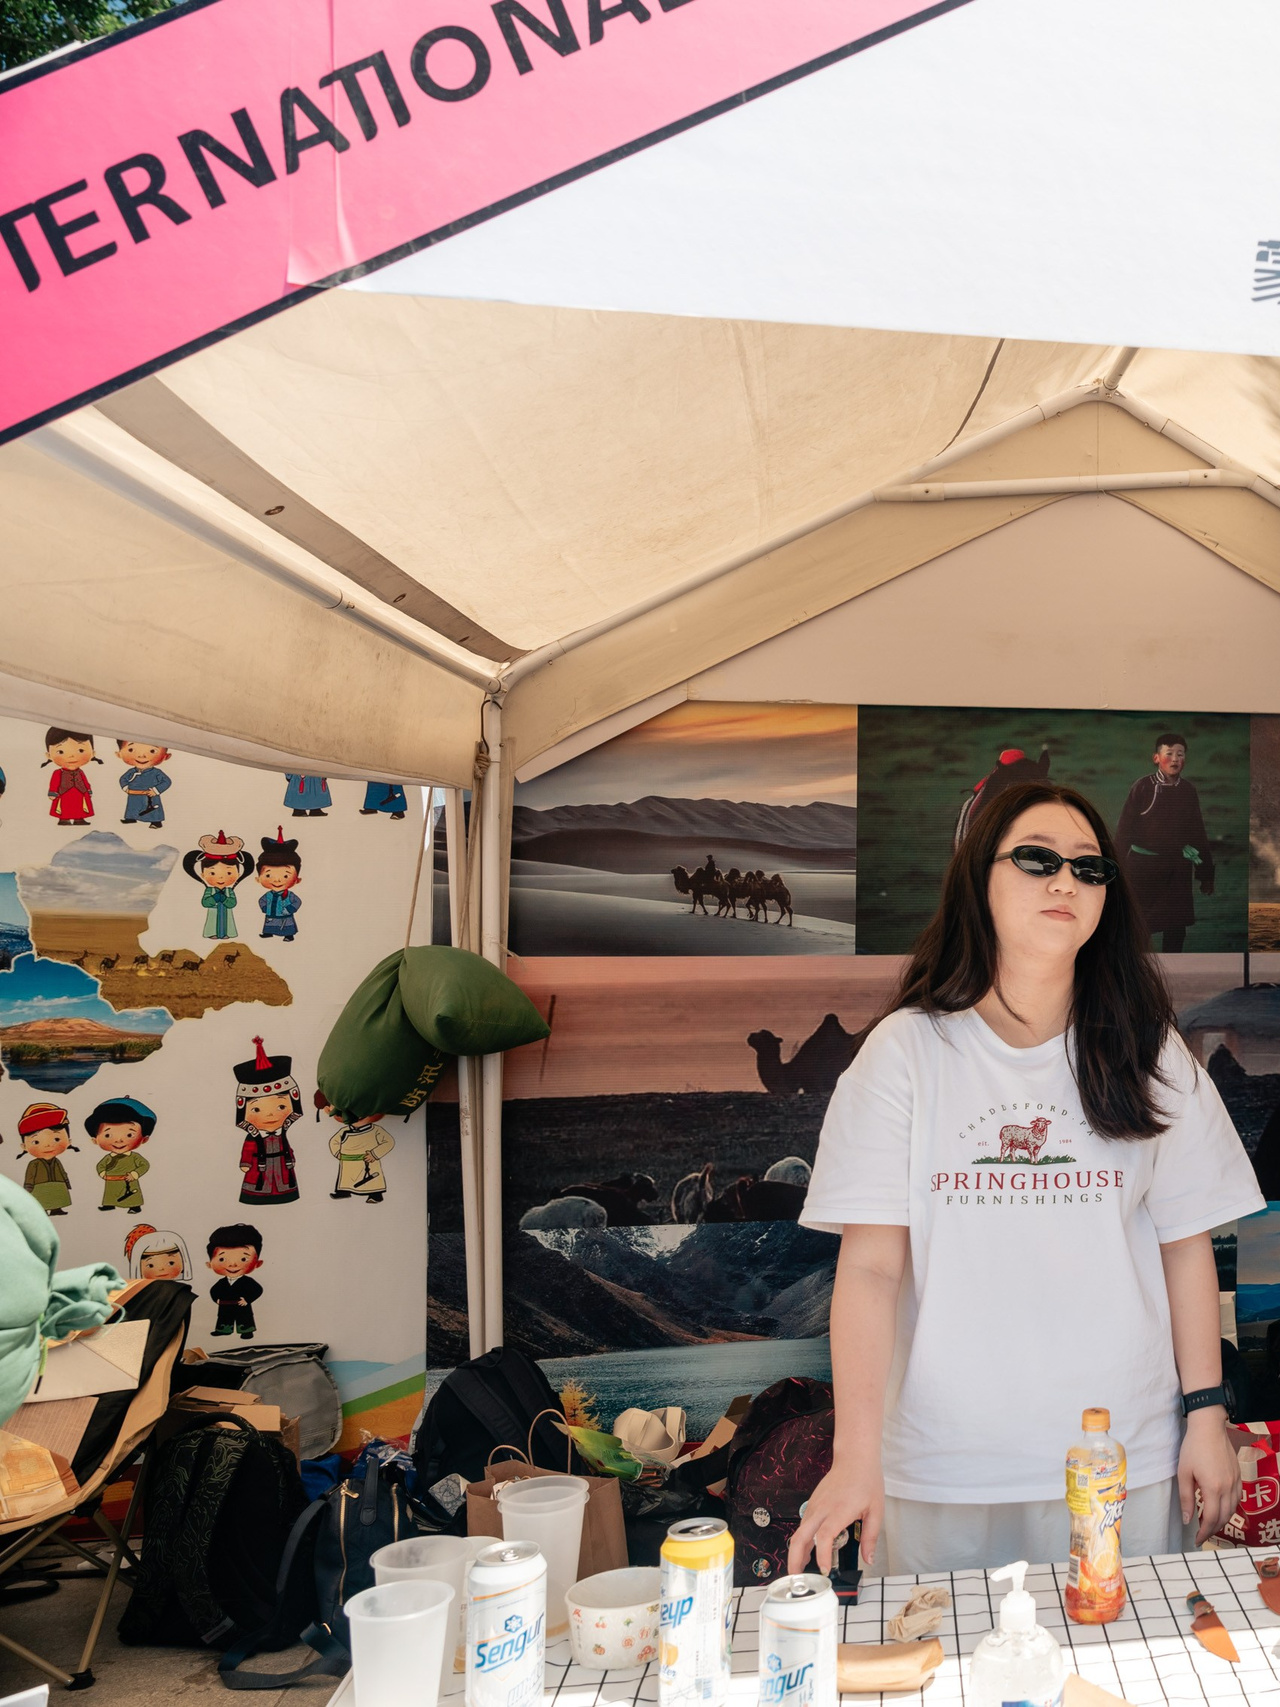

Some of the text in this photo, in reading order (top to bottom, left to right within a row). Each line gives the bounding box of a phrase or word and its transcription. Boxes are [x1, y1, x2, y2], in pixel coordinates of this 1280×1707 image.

[399, 1048, 444, 1107] 防汛
[930, 1169, 1125, 1193] SPRINGHOUSE
[945, 1192, 1104, 1206] FURNISHINGS
[474, 1611, 545, 1669] Sengur
